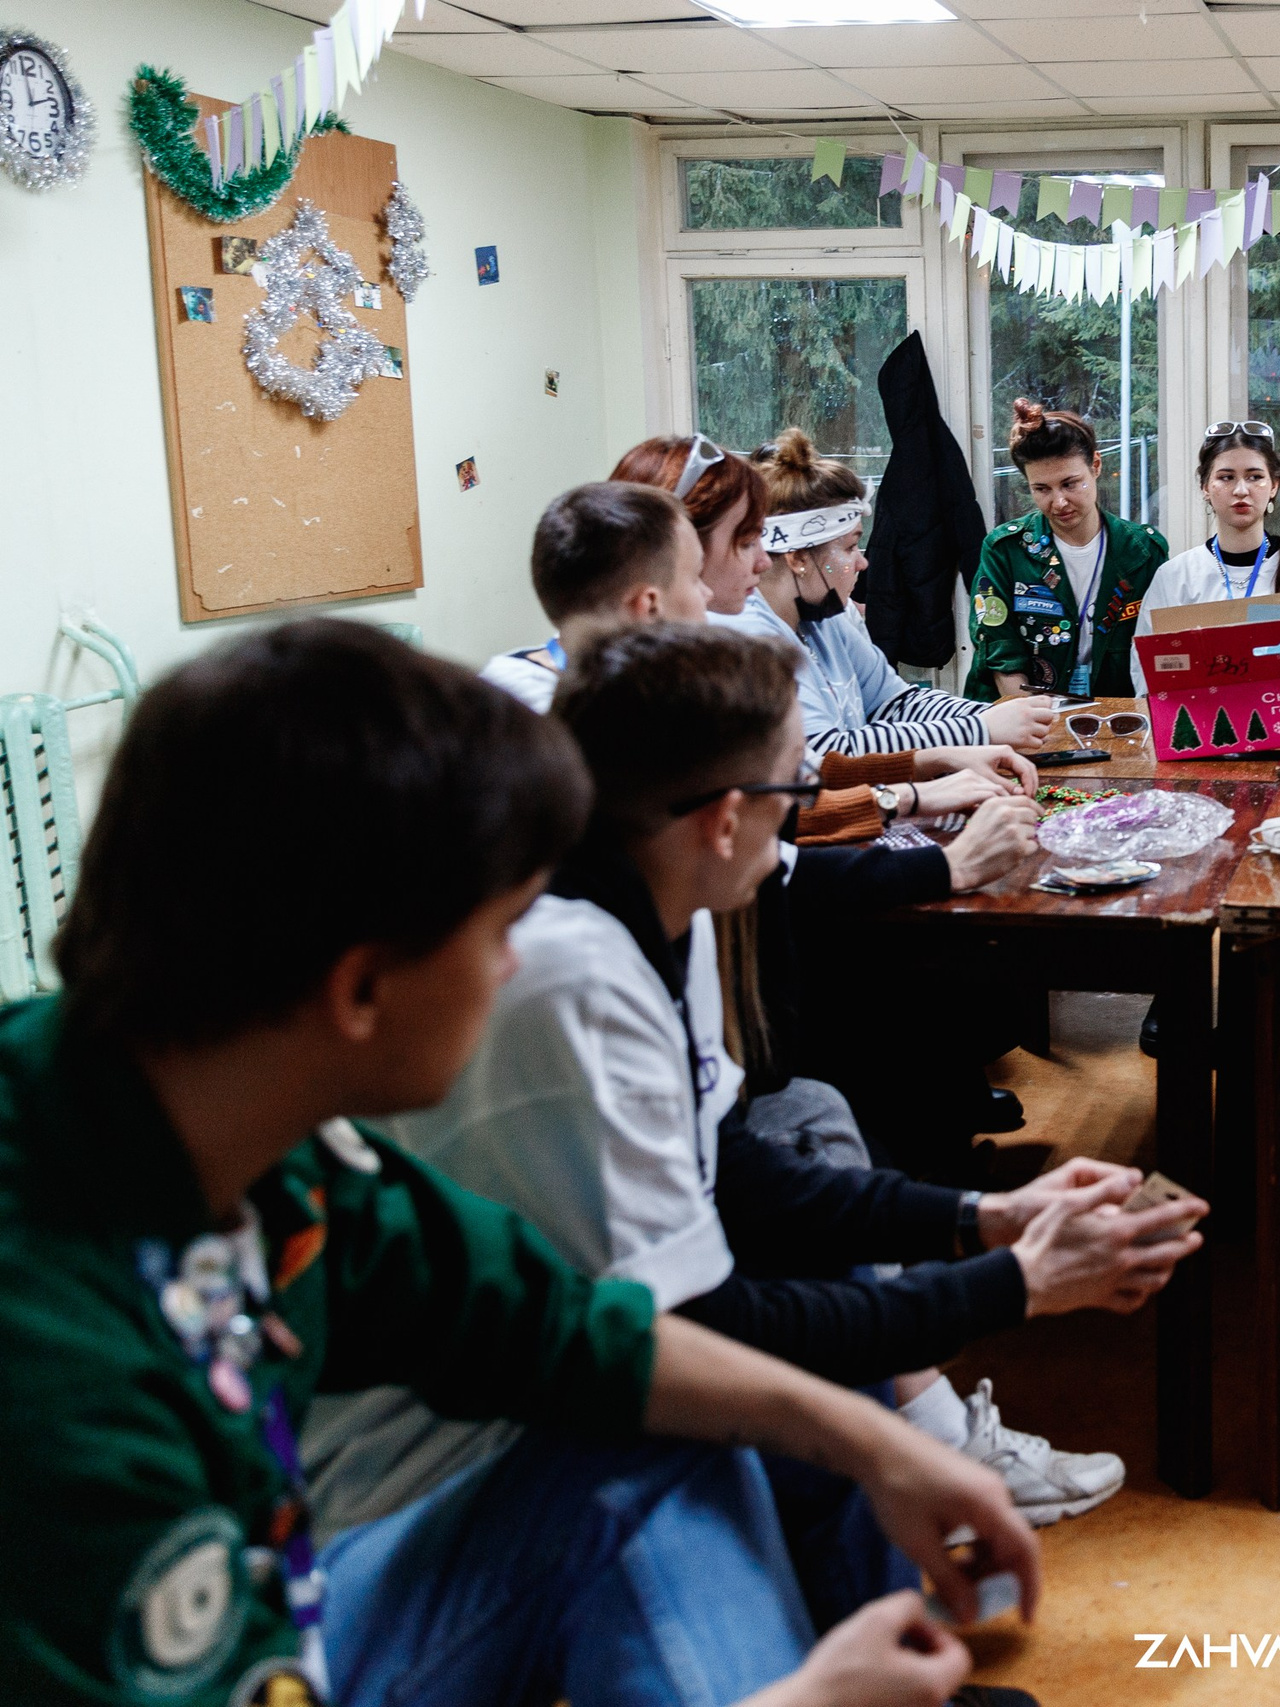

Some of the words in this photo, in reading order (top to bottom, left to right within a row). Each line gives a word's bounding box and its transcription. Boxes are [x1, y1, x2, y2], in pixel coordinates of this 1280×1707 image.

[19, 55, 36, 78] 12
[45, 80, 54, 94] 2
[47, 97, 60, 118] 3
[50, 120, 59, 135] 4
[18, 129, 25, 144] 7
[29, 131, 41, 152] 6
[44, 133, 52, 148] 5
